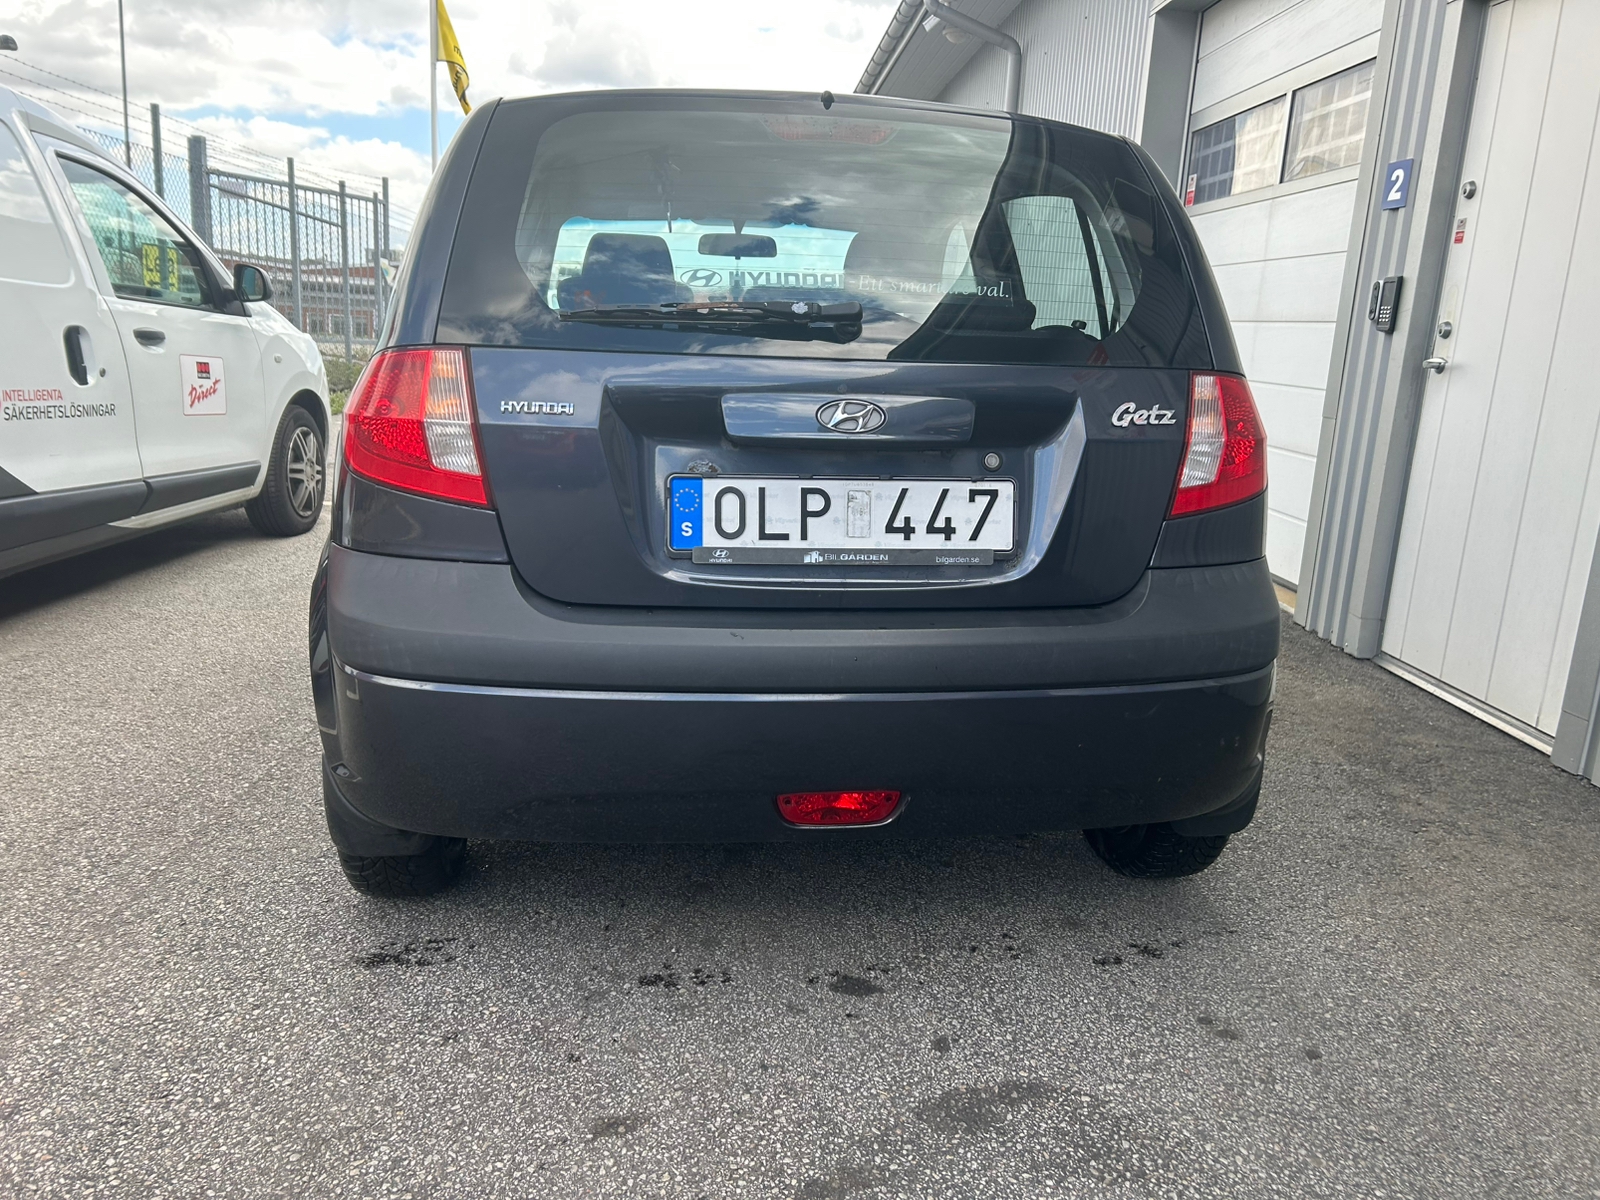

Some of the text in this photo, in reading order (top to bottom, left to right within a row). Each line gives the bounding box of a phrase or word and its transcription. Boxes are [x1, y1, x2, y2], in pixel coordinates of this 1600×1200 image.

[1386, 168, 1405, 202] 2
[729, 271, 845, 288] HYUNDAI
[889, 279, 970, 296] smarte
[976, 281, 1009, 298] val.
[2, 389, 63, 402] INTELLIGENTA
[188, 377, 221, 408] Direct
[3, 402, 116, 421] SÄKERHETSLÖSNINGAR
[500, 400, 575, 416] HYUNDAI
[1111, 401, 1177, 428] Getz
[714, 485, 999, 542] OLP 447
[680, 521, 693, 537] S
